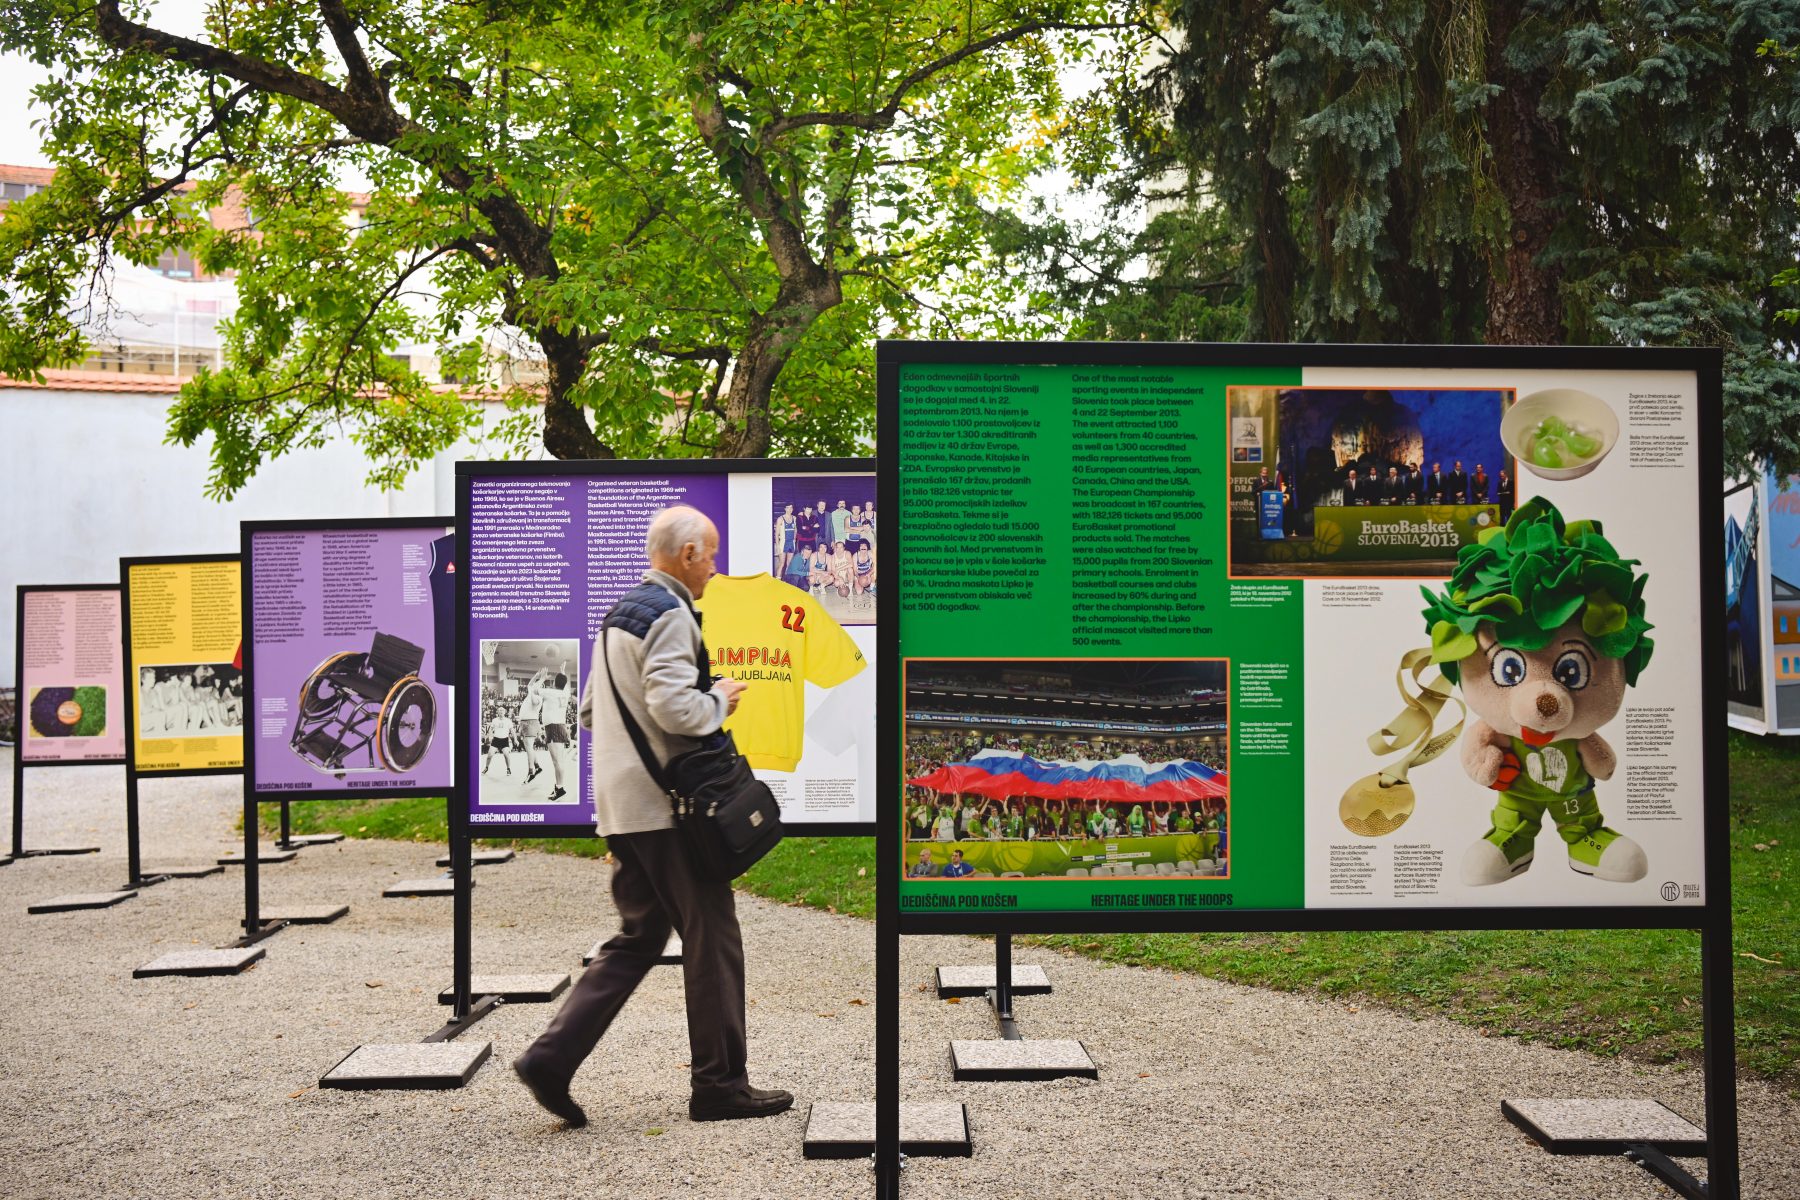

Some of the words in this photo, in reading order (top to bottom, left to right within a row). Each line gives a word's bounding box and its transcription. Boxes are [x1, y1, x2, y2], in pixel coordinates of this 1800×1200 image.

[1071, 374, 1089, 383] One
[1091, 374, 1100, 383] of
[1102, 375, 1116, 383] the
[1118, 375, 1139, 383] most
[1141, 375, 1174, 383] notable
[1072, 386, 1108, 396] sporting
[1110, 386, 1138, 395] events
[1140, 386, 1148, 395] in
[1149, 386, 1204, 397] independent
[1071, 397, 1108, 406] Slovenia
[1110, 397, 1129, 406] took
[1130, 398, 1154, 408] place
[1156, 398, 1194, 406] between
[1072, 408, 1077, 417] 4
[1079, 409, 1096, 417] and
[1097, 409, 1108, 417] 22
[1109, 409, 1157, 420] September
[1159, 409, 1181, 418] 2013.
[1072, 420, 1088, 429] The
[1090, 420, 1113, 429] event
[1115, 420, 1156, 429] attracted
[1158, 421, 1178, 430] 1,100
[1072, 431, 1118, 440] volunteers
[1119, 432, 1140, 440] from
[1142, 432, 1153, 440] 40
[1154, 432, 1198, 442] countries,
[1084, 443, 1101, 451] well
[1116, 443, 1138, 453] 1,300
[1139, 443, 1186, 452] accredited
[1071, 454, 1098, 463] media
[1100, 455, 1169, 465] representatives
[1170, 455, 1192, 463] from
[1072, 466, 1084, 474] 40
[1085, 466, 1127, 476] European
[1128, 466, 1171, 476] countries,
[1172, 466, 1202, 477] Japan,
[1072, 477, 1108, 487] Canada,
[1109, 477, 1135, 486] China
[1136, 477, 1153, 486] and
[1154, 477, 1168, 486] the
[1170, 478, 1190, 486] USA.
[1072, 488, 1088, 497] The
[1090, 489, 1132, 499] European
[1133, 489, 1195, 500] Championship
[1091, 500, 1136, 509] broadcast
[1137, 500, 1145, 509] in
[1148, 500, 1160, 509] 167
[1162, 500, 1206, 510] countries,
[1072, 511, 1090, 520] with
[1092, 511, 1122, 521] 182,126
[1124, 512, 1152, 520] tickets
[1154, 512, 1171, 520] and
[1172, 512, 1203, 522] 95,000
[1072, 523, 1121, 531] EuroBasket
[1123, 523, 1176, 534] promotional
[1362, 519, 1454, 534] EuroBasket
[1358, 534, 1420, 546] SLOVENIA
[1420, 533, 1460, 548] 2013
[781, 604, 806, 633] 22
[732, 670, 792, 682] LJUBLJANA
[256, 782, 283, 790] DEDIŠČINA
[294, 781, 313, 789] KOŠEM
[1563, 799, 1579, 815] 13
[470, 812, 505, 823] DEDIŠČINA
[506, 813, 520, 823] POD
[520, 812, 545, 823] KOŠEM
[901, 893, 956, 908] DEDIŠČINA
[958, 894, 980, 908] POD
[981, 893, 1018, 907] KOŠEM
[1091, 893, 1140, 907] HERITAGE
[1142, 893, 1176, 907] UNDER
[1177, 893, 1197, 906] THE
[1199, 893, 1234, 906] HOOPS
